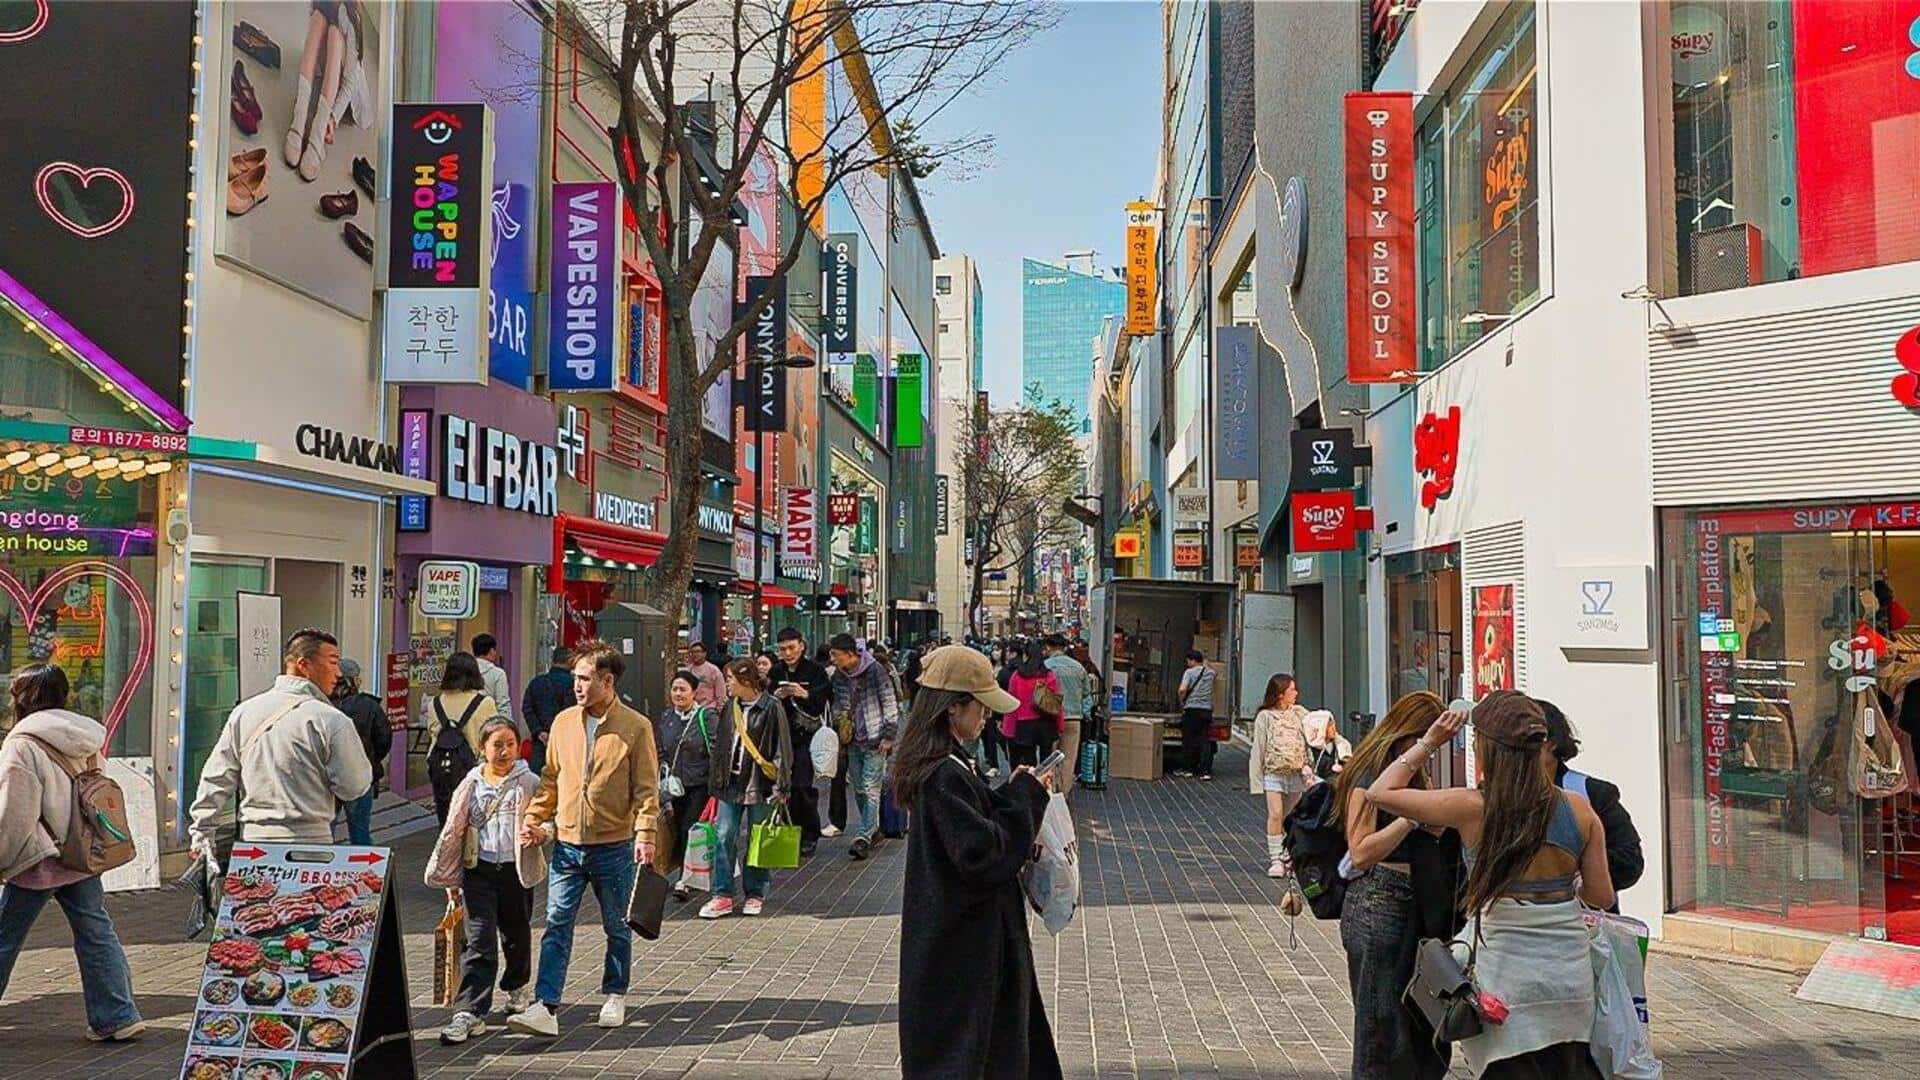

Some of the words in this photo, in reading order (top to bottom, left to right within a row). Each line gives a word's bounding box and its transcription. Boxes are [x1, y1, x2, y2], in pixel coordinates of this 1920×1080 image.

[1670, 32, 1714, 54] Supy
[1371, 139, 1389, 229] SUPY
[412, 165, 436, 270] HOUSE
[435, 153, 459, 282] WAPPEN
[565, 190, 599, 381] VAPESHOP
[835, 242, 848, 326] CONVERSE
[1372, 241, 1391, 359] SEOUL
[407, 305, 460, 332] 착한
[406, 338, 459, 364] 구두
[412, 415, 421, 449] VAPE
[446, 414, 558, 516] ELFBAR
[787, 488, 812, 556] MART
[1302, 505, 1345, 527] Supy
[1793, 509, 1856, 528] SUPY
[26, 533, 89, 552] house
[429, 570, 461, 583] VAPE
